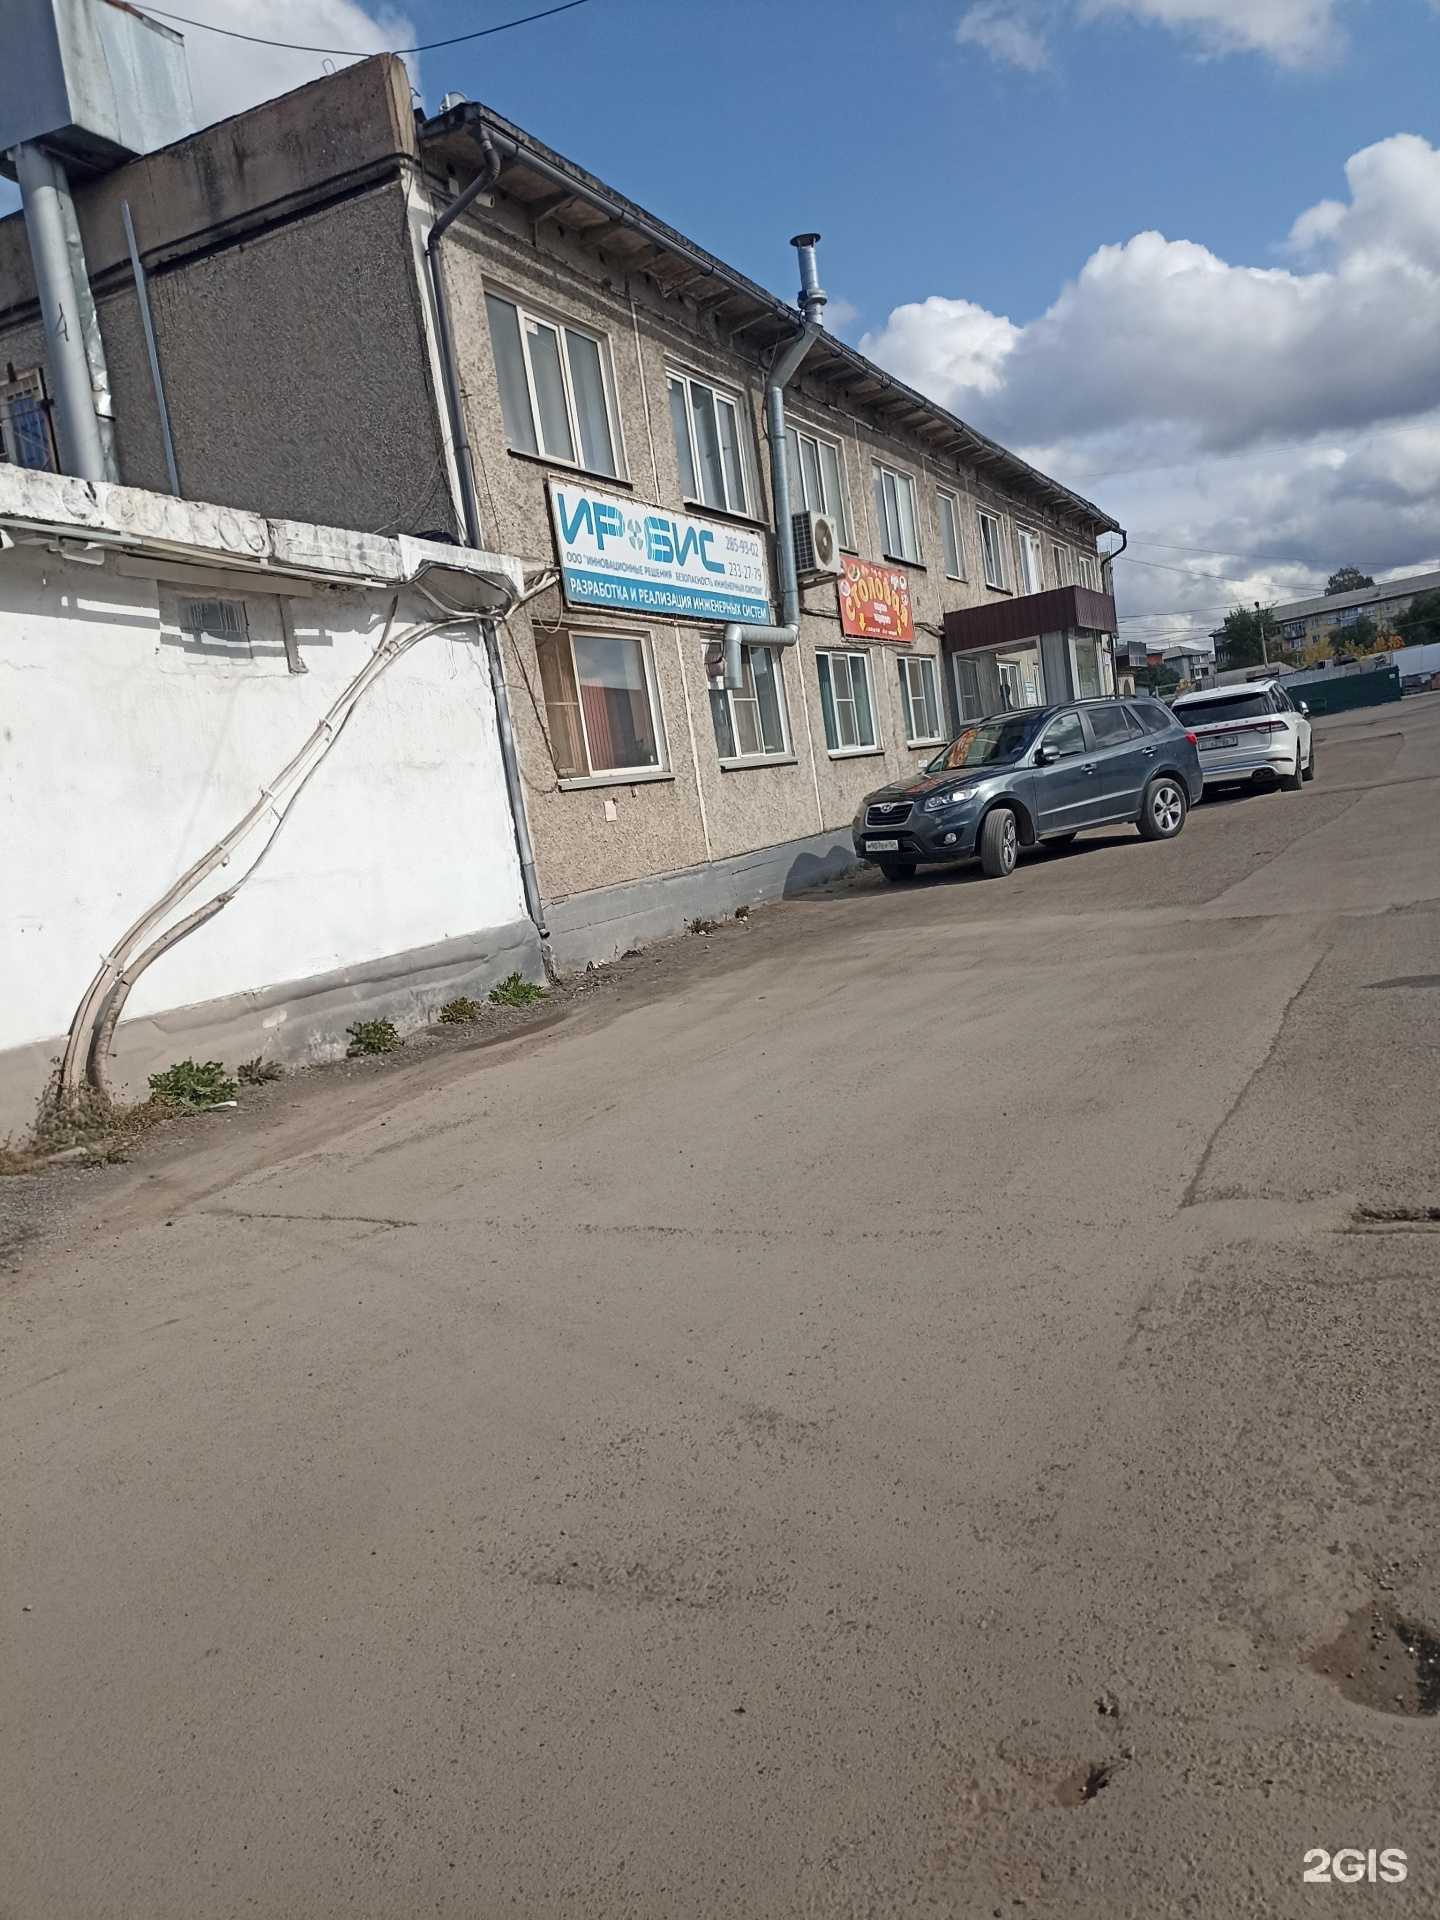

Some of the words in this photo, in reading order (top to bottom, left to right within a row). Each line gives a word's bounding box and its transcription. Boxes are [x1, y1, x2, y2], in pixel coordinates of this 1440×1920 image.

[566, 551, 583, 564] ООО
[569, 577, 629, 601] РАЗРАБОТКА
[630, 588, 638, 602] И
[639, 588, 693, 610] РЕАЛИЗАЦИЯ
[693, 599, 742, 616] ИНЖЕНЕРНЫХ
[742, 603, 767, 619] СИСТЕМ
